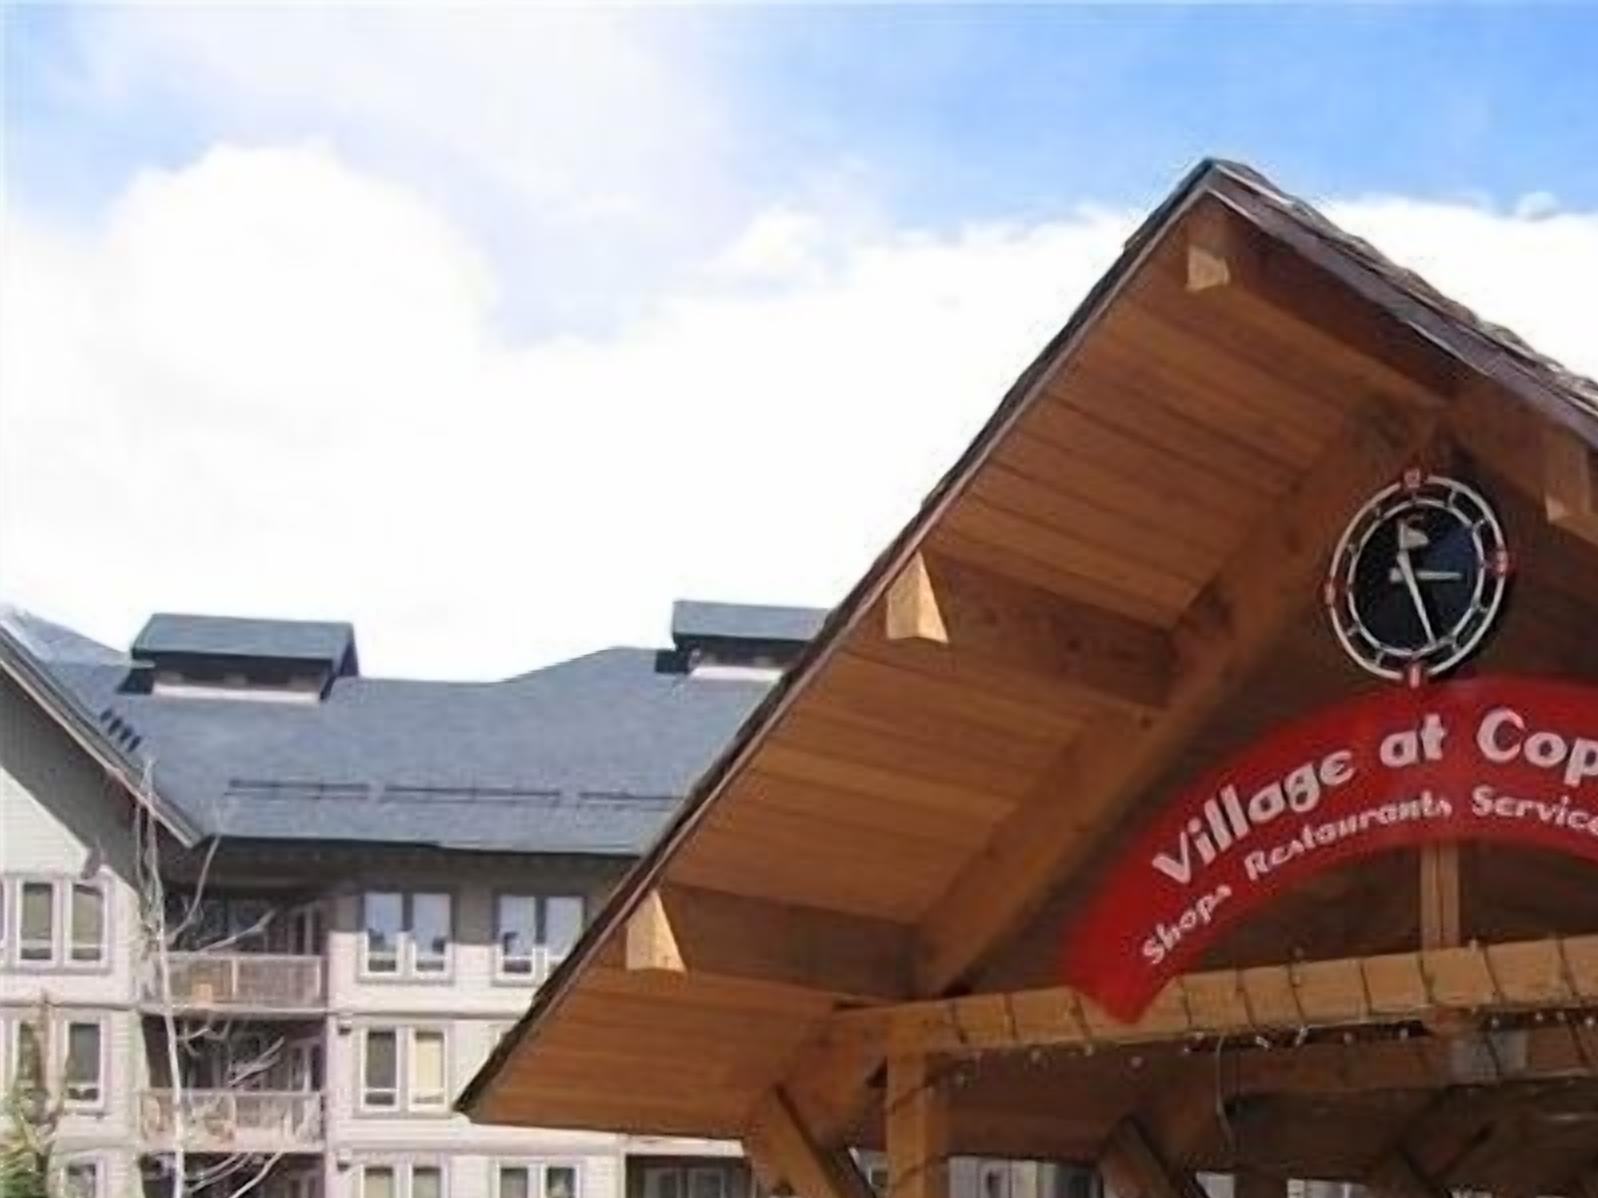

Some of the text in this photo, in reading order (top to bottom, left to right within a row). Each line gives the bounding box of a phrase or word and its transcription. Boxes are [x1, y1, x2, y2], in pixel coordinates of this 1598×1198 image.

[1142, 884, 1232, 964] Shops
[1243, 790, 1453, 880] Restaurants
[1151, 749, 1356, 884] Village
[1379, 713, 1447, 768] at
